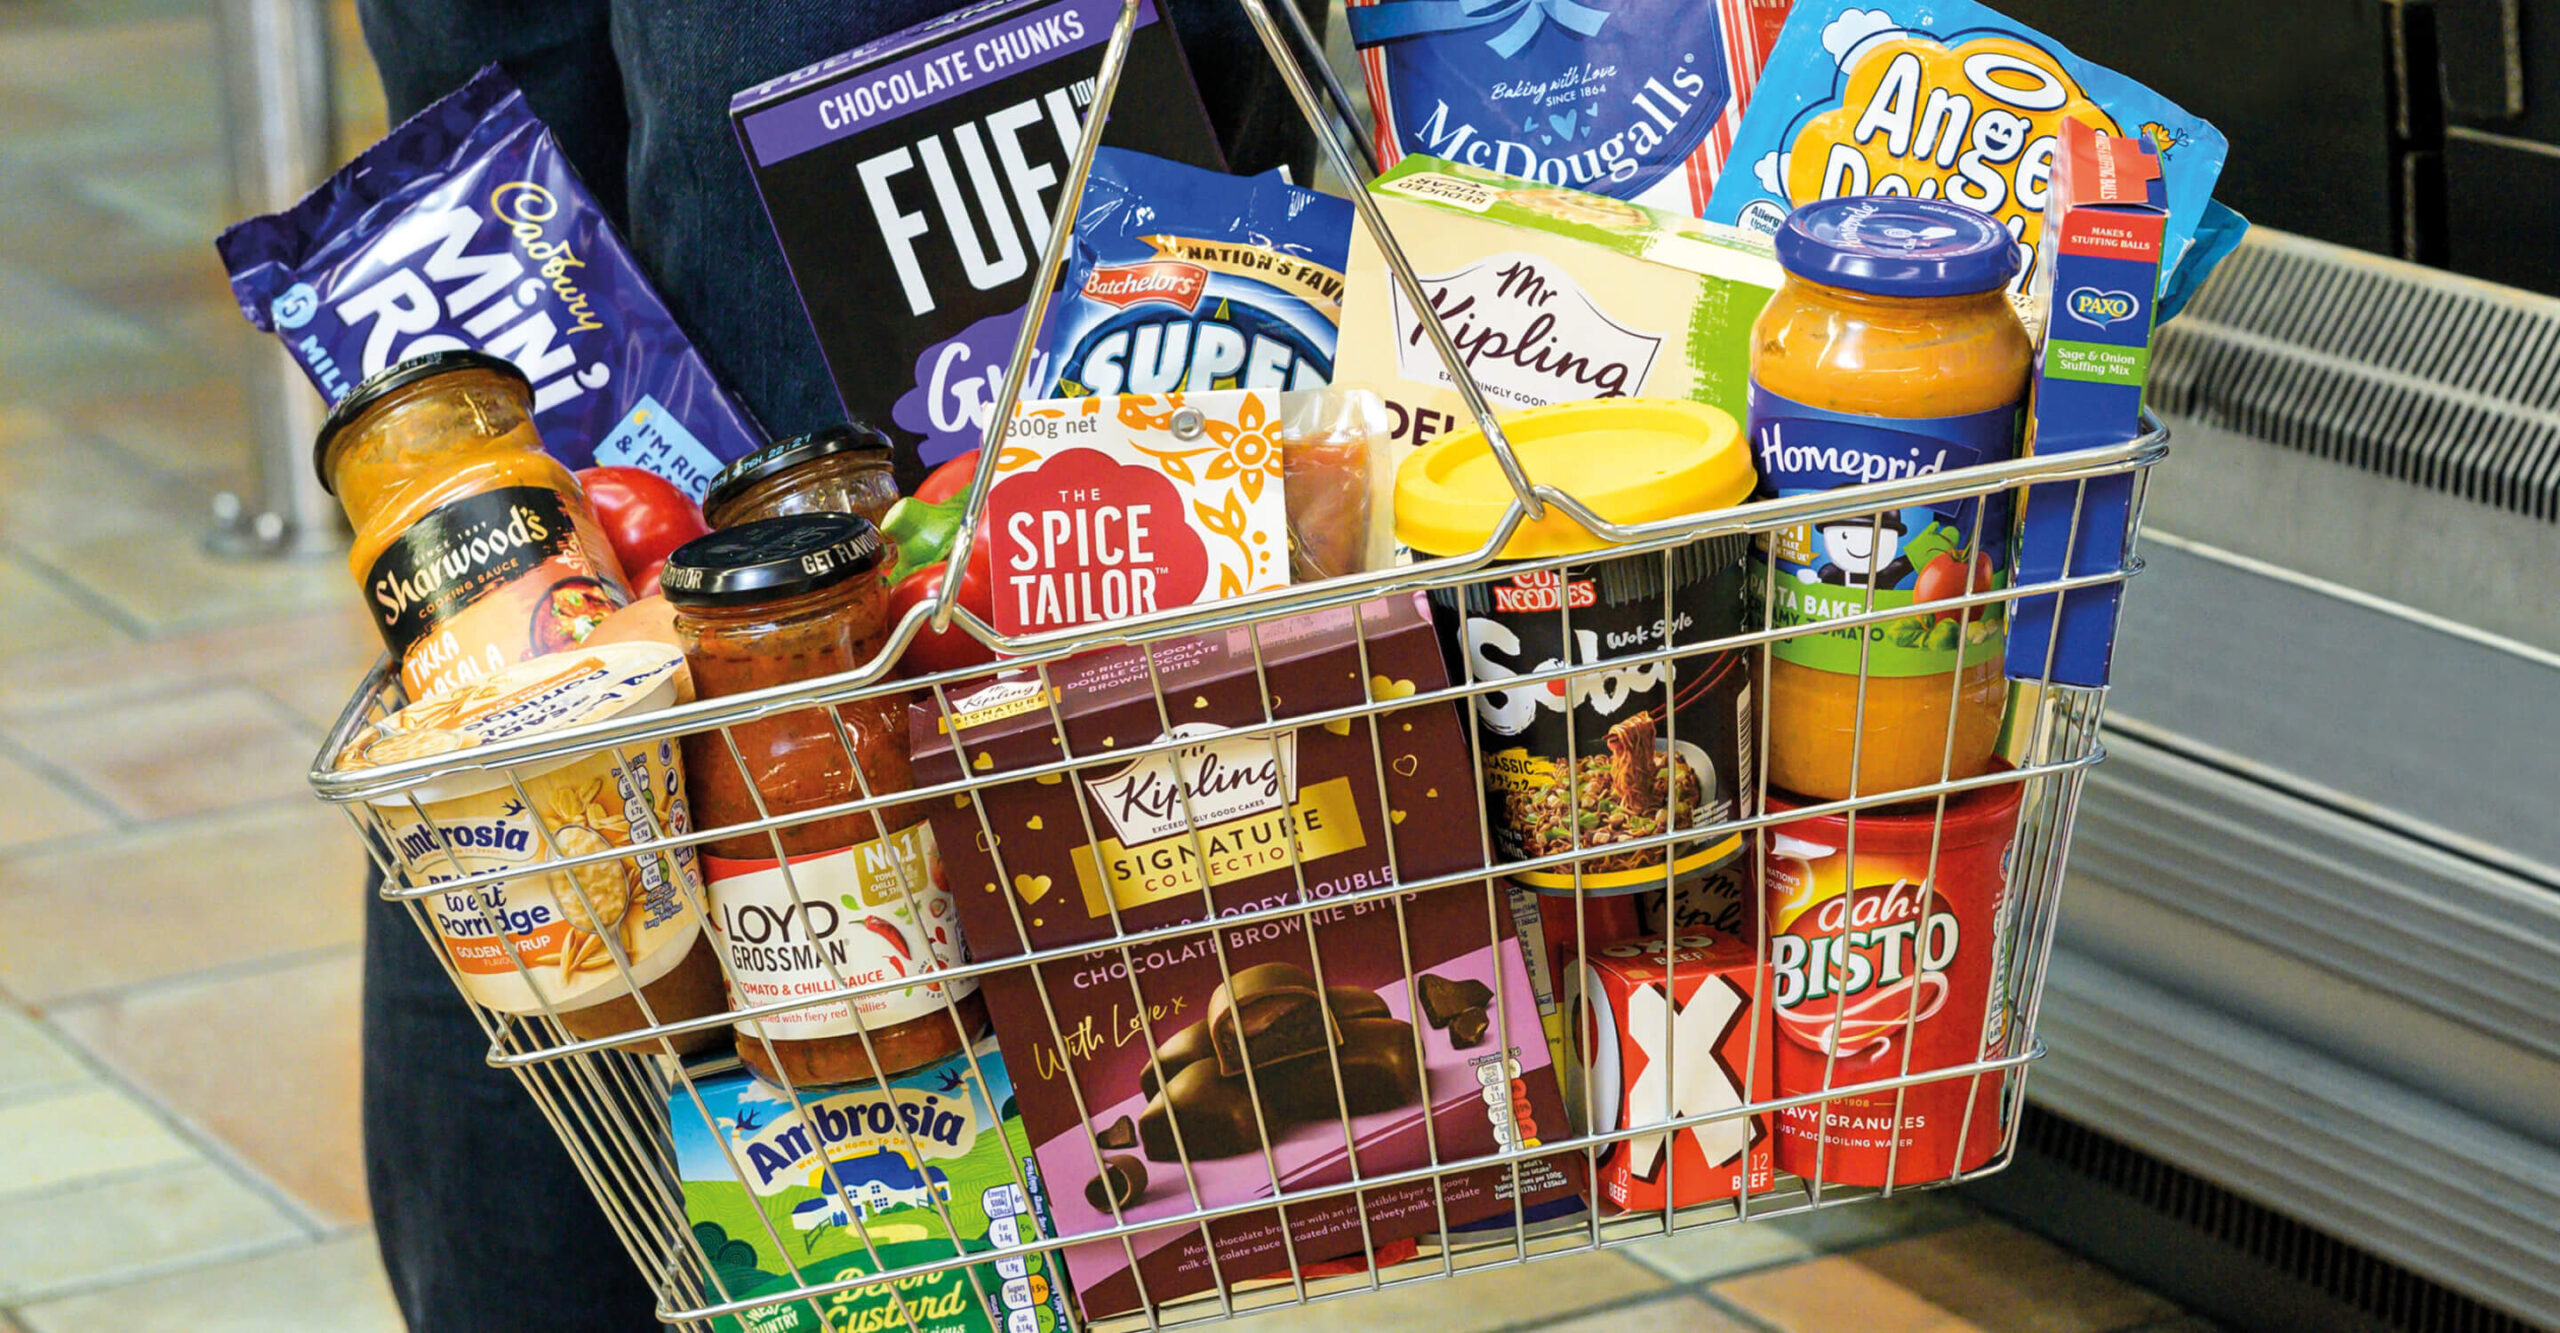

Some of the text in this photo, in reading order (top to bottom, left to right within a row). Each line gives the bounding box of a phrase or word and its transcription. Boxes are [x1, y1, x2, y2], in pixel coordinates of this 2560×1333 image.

[818, 9, 1086, 130] CHOCOLATE CHUNKS
[1491, 63, 1619, 104] Baking with Love
[1544, 84, 1608, 107] SINCE 1864
[1854, 51, 2058, 214] Ange
[2071, 235, 2151, 251] STUFFING BALLS
[2091, 226, 2134, 239] MAKES 6
[491, 181, 604, 335] Cadbury
[1084, 269, 1196, 298] Batchelors
[1496, 260, 1558, 308] Mr
[2078, 295, 2129, 318] PAXO
[1408, 287, 1630, 399] Kipling
[2057, 347, 2136, 365] Sage & Onion
[2060, 359, 2131, 376] Stuffing Mix
[1065, 414, 1098, 434] net
[637, 423, 672, 458] I'M
[671, 455, 711, 495] RIC
[1760, 422, 1949, 483] Homeprid
[1058, 486, 1102, 503] THE
[1007, 503, 1155, 571] SPICE
[375, 503, 549, 627] Sharwood's
[801, 550, 835, 576] GET
[417, 556, 520, 620] COOKING SAUCE
[1750, 573, 1864, 620] PATA BAKE
[1606, 611, 1694, 650] Wok Syle
[406, 629, 460, 689] TIKKA
[1080, 669, 1096, 678] 10
[1099, 658, 1136, 674] RICH
[1152, 640, 1205, 659] GOOEY
[1087, 658, 1201, 693] BROWNI BITES
[1067, 669, 1128, 690] DOUBLE
[954, 694, 1047, 723] SIGNATURE
[962, 685, 1036, 710] Kipling
[1113, 751, 1282, 823] Kipling
[1209, 806, 1238, 819] GOOD
[1238, 798, 1266, 812] CAKES
[1112, 808, 1323, 881] SIGNATURE
[1701, 872, 1740, 899] Mr
[436, 904, 551, 936] Porridge
[723, 899, 840, 943] LOYD
[1817, 876, 1931, 934] aah!
[455, 944, 501, 961] GOLDEN
[731, 938, 848, 972] GROSSMAN
[1072, 937, 1219, 989] CHOCOLATE
[1600, 934, 1715, 959] OXO
[1770, 910, 1961, 1009] BISTO
[781, 983, 791, 996] &
[793, 979, 837, 995] CHILLI
[782, 1011, 804, 1023] with
[803, 1009, 829, 1023] fiery
[830, 1007, 849, 1019] red
[1033, 1014, 1105, 1081] With
[1112, 1000, 1169, 1049] Love
[1628, 973, 1762, 1181] X
[1825, 1113, 1926, 1131] GRANUES
[745, 1095, 966, 1187] Ambrosia
[796, 1137, 889, 1170] Welcme Home To
[1824, 1134, 1871, 1148] BOILING
[1874, 1138, 1914, 1149] WAER
[1617, 1167, 1628, 1188] 12
[1751, 1152, 1769, 1172] 12
[1731, 1171, 1769, 1191] BEF
[1178, 1186, 1481, 1273] milk chcolate sauce coated in velvety milk cocolate
[1215, 1228, 1265, 1249] chocolate
[1265, 1220, 1306, 1237] bronie
[1308, 1211, 1330, 1226] with
[1332, 1208, 1345, 1219] an
[1346, 1193, 1398, 1215] irristible
[1398, 1187, 1424, 1202] layer
[751, 1310, 799, 1333] OUNTRY
[819, 1279, 968, 1333] Custard
